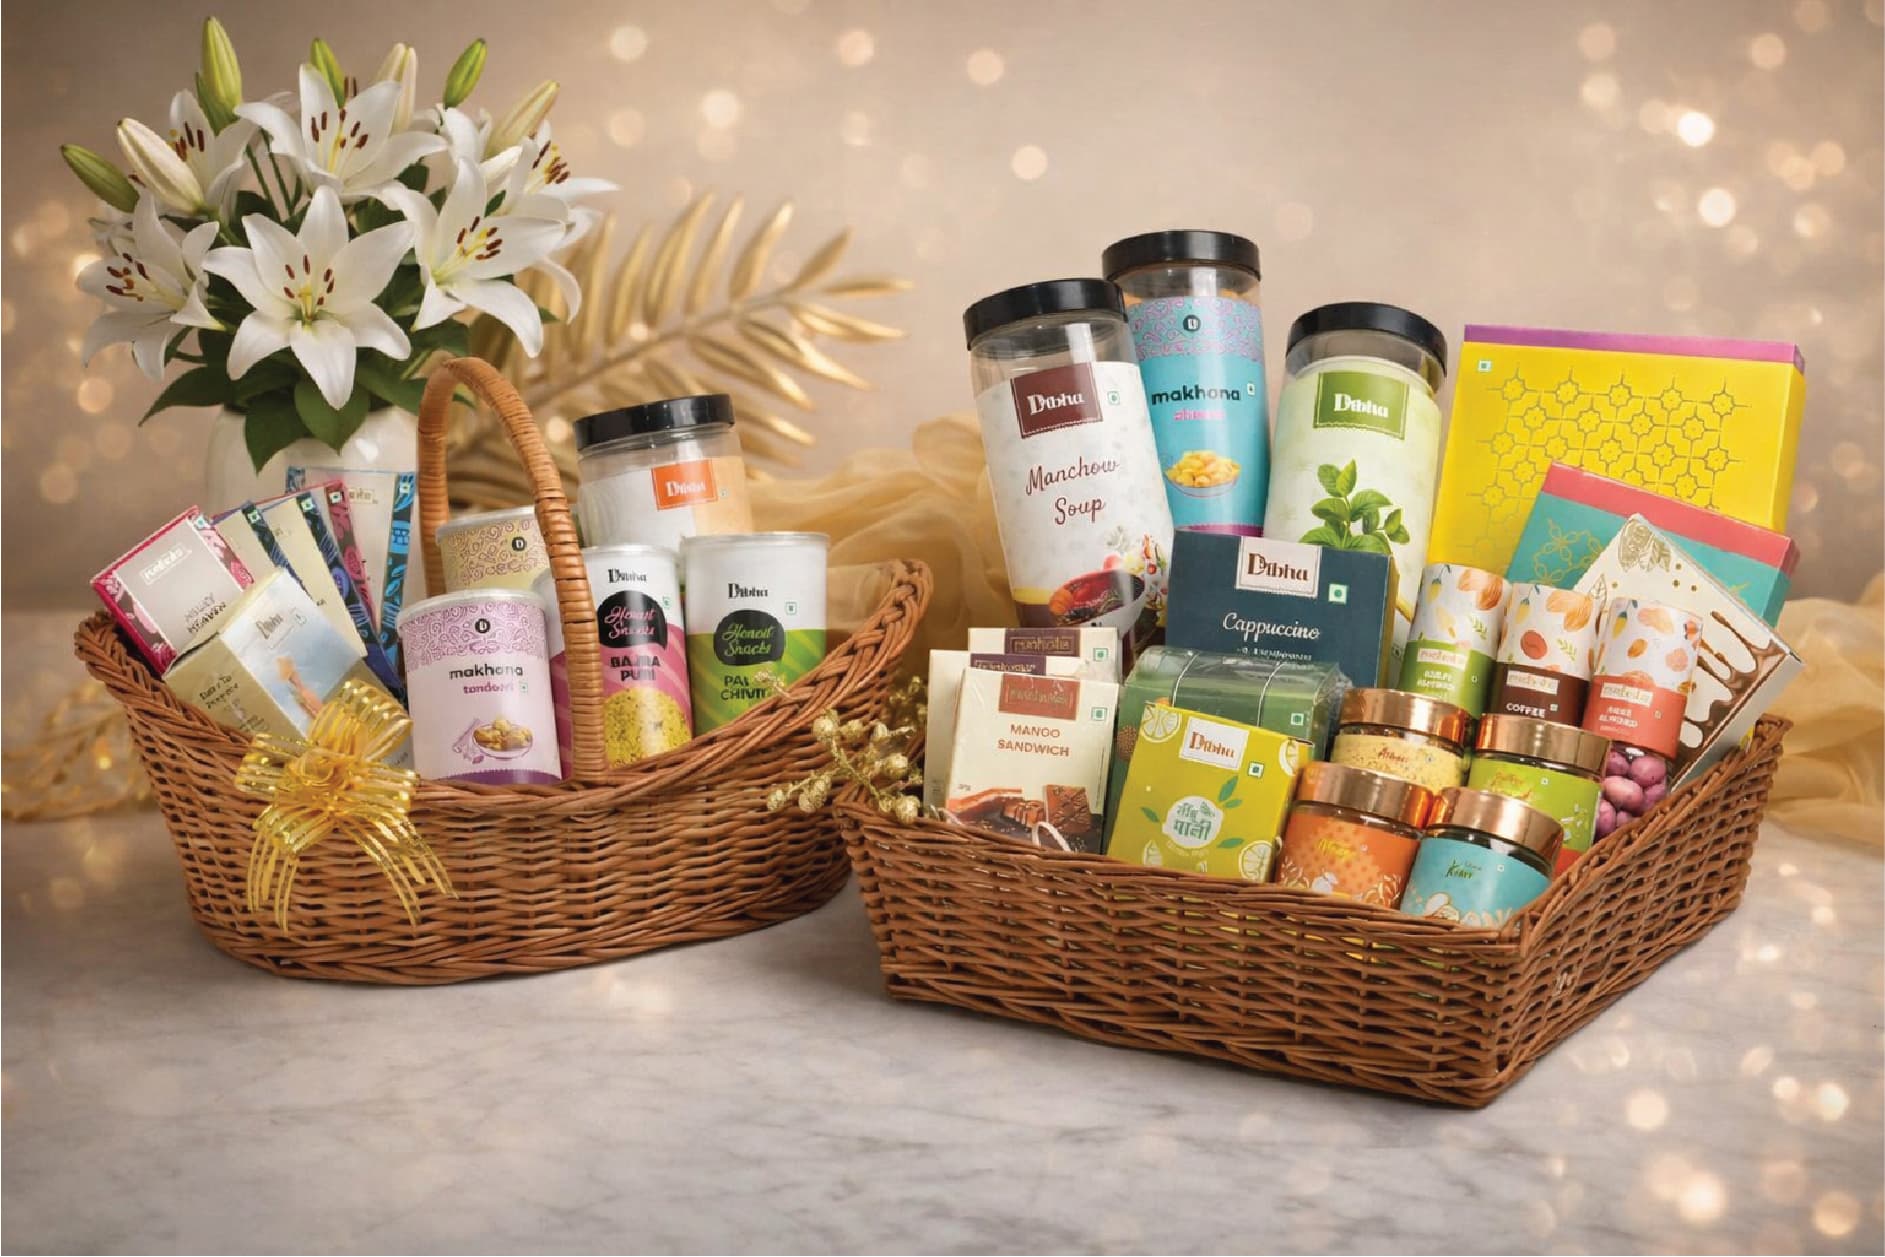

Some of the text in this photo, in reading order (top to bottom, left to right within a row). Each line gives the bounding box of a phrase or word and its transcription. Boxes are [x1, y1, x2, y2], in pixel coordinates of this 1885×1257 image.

[1025, 456, 1120, 496] Manchow
[1054, 496, 1106, 526] Soup
[1222, 612, 1321, 642] Cappuccino
[998, 739, 1070, 756] SANDWICH
